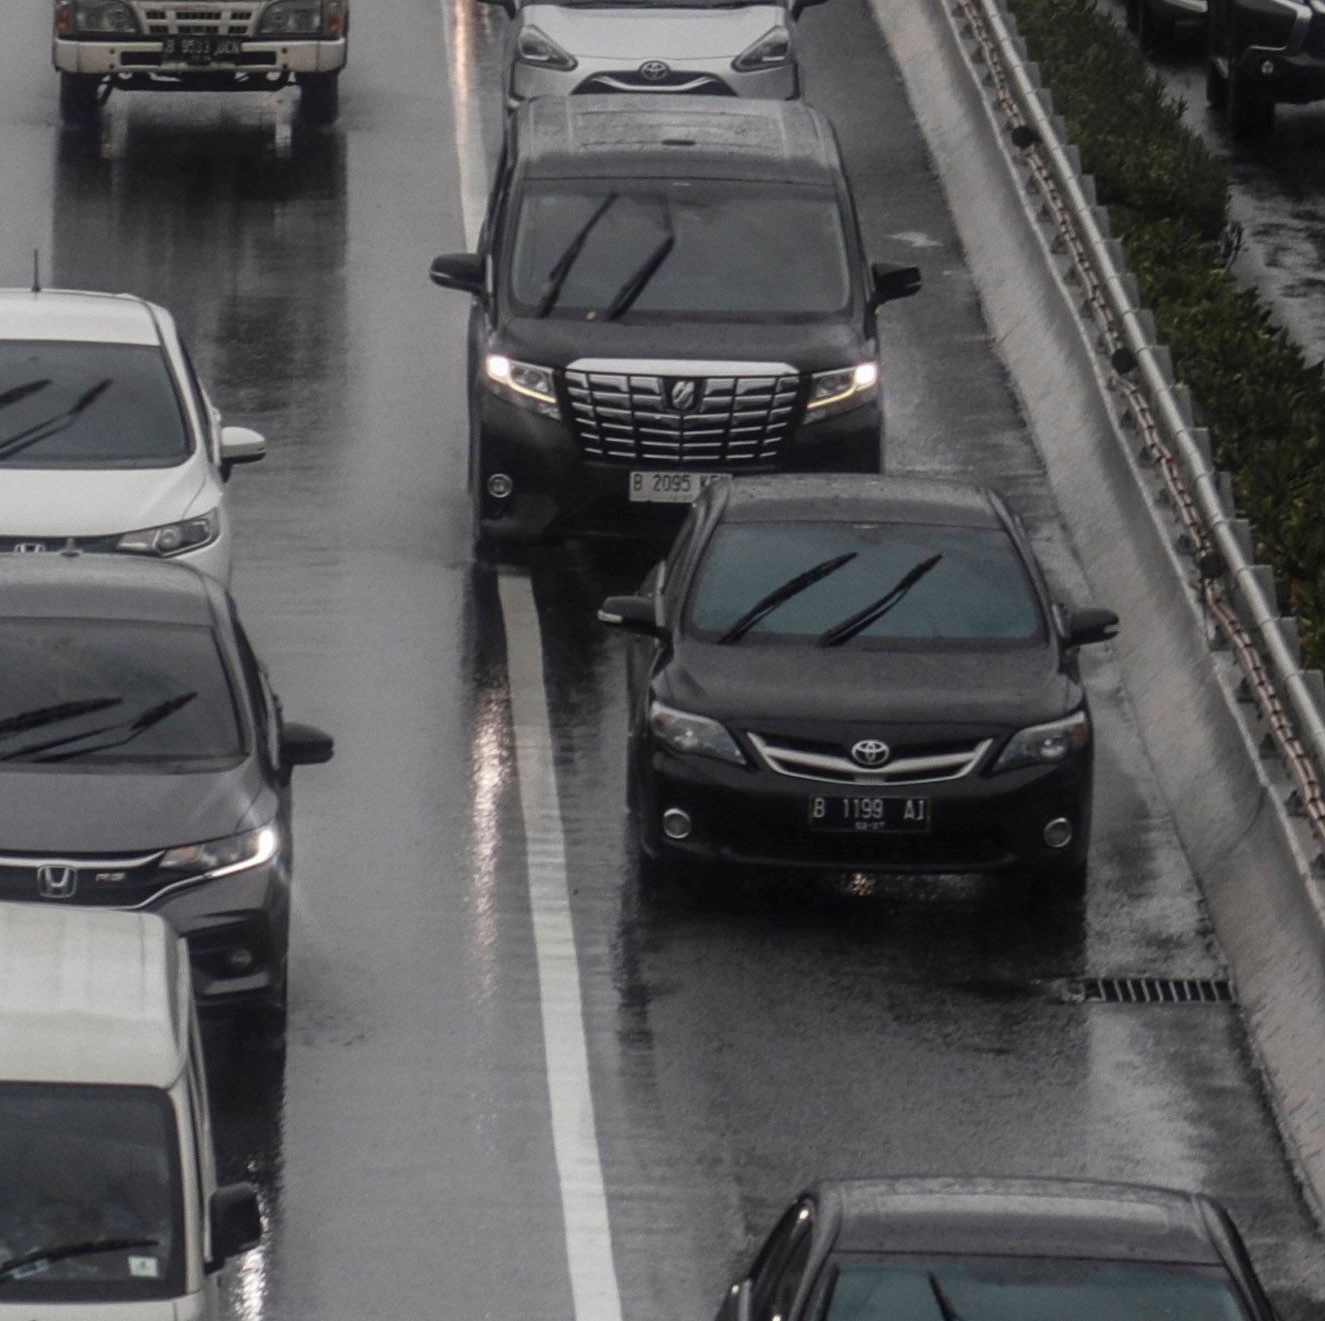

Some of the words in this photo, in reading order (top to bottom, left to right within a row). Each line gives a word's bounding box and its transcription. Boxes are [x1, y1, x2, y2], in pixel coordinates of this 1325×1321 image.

[633, 473, 644, 491] B
[652, 474, 692, 492] 2095
[813, 797, 826, 819] B
[842, 798, 884, 819] 1199
